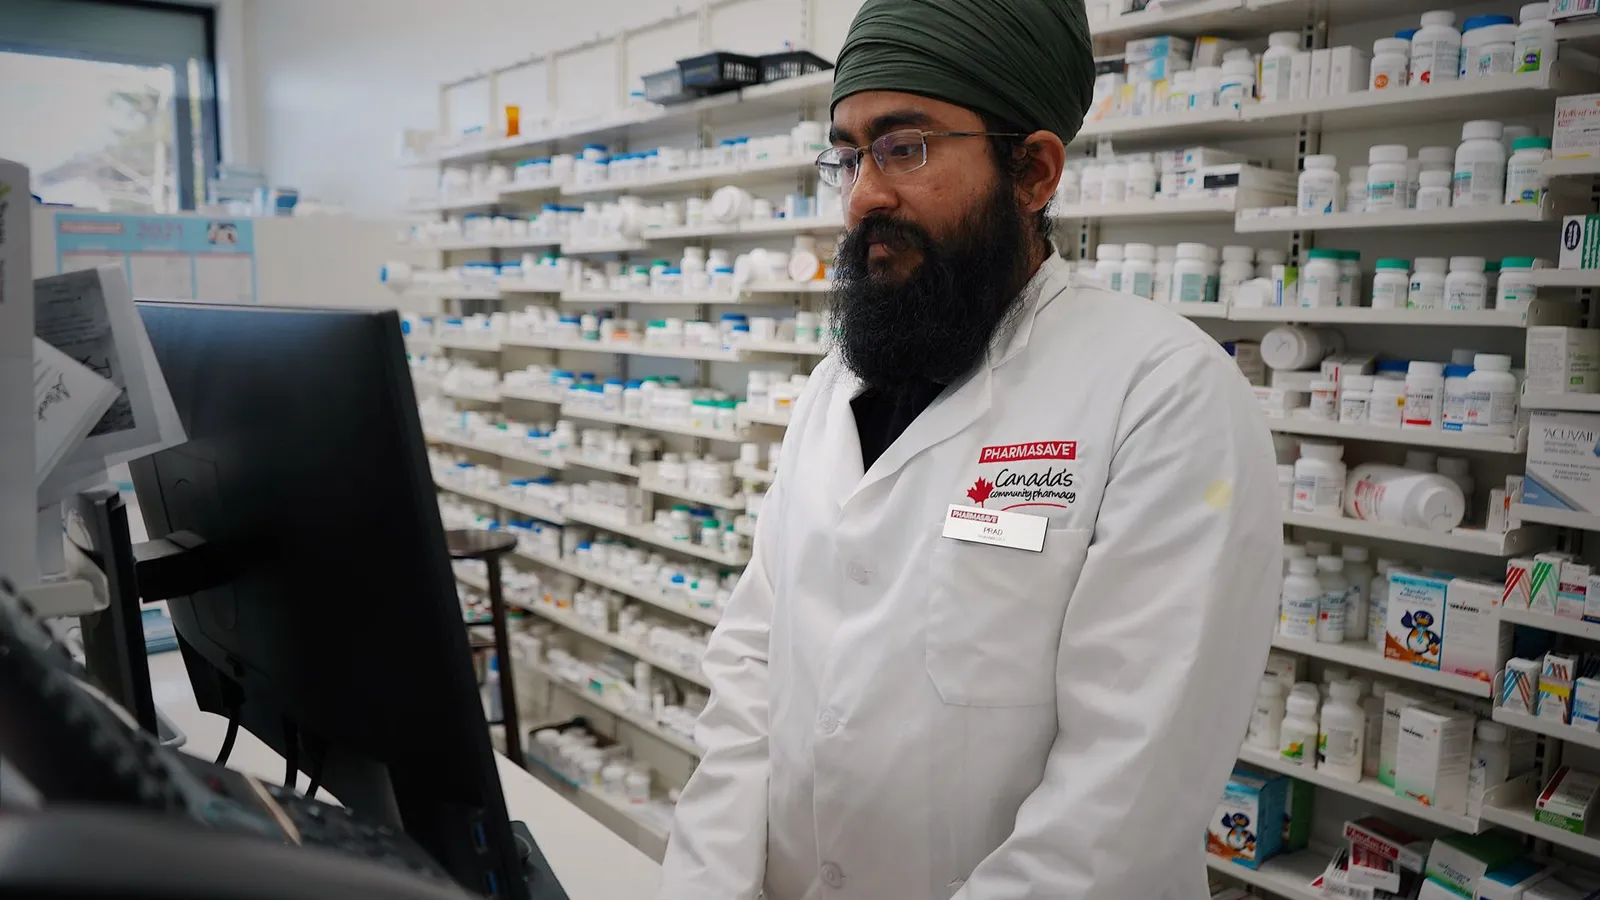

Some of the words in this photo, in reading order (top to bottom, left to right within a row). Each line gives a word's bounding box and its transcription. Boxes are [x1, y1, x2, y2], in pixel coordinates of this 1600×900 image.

[136, 222, 183, 240] 2021
[983, 442, 1071, 461] PHARMASAVE
[995, 466, 1074, 487] Canada's
[990, 488, 1032, 501] community
[1032, 488, 1076, 503] pharmacy
[952, 510, 998, 524] PHARMASAVE
